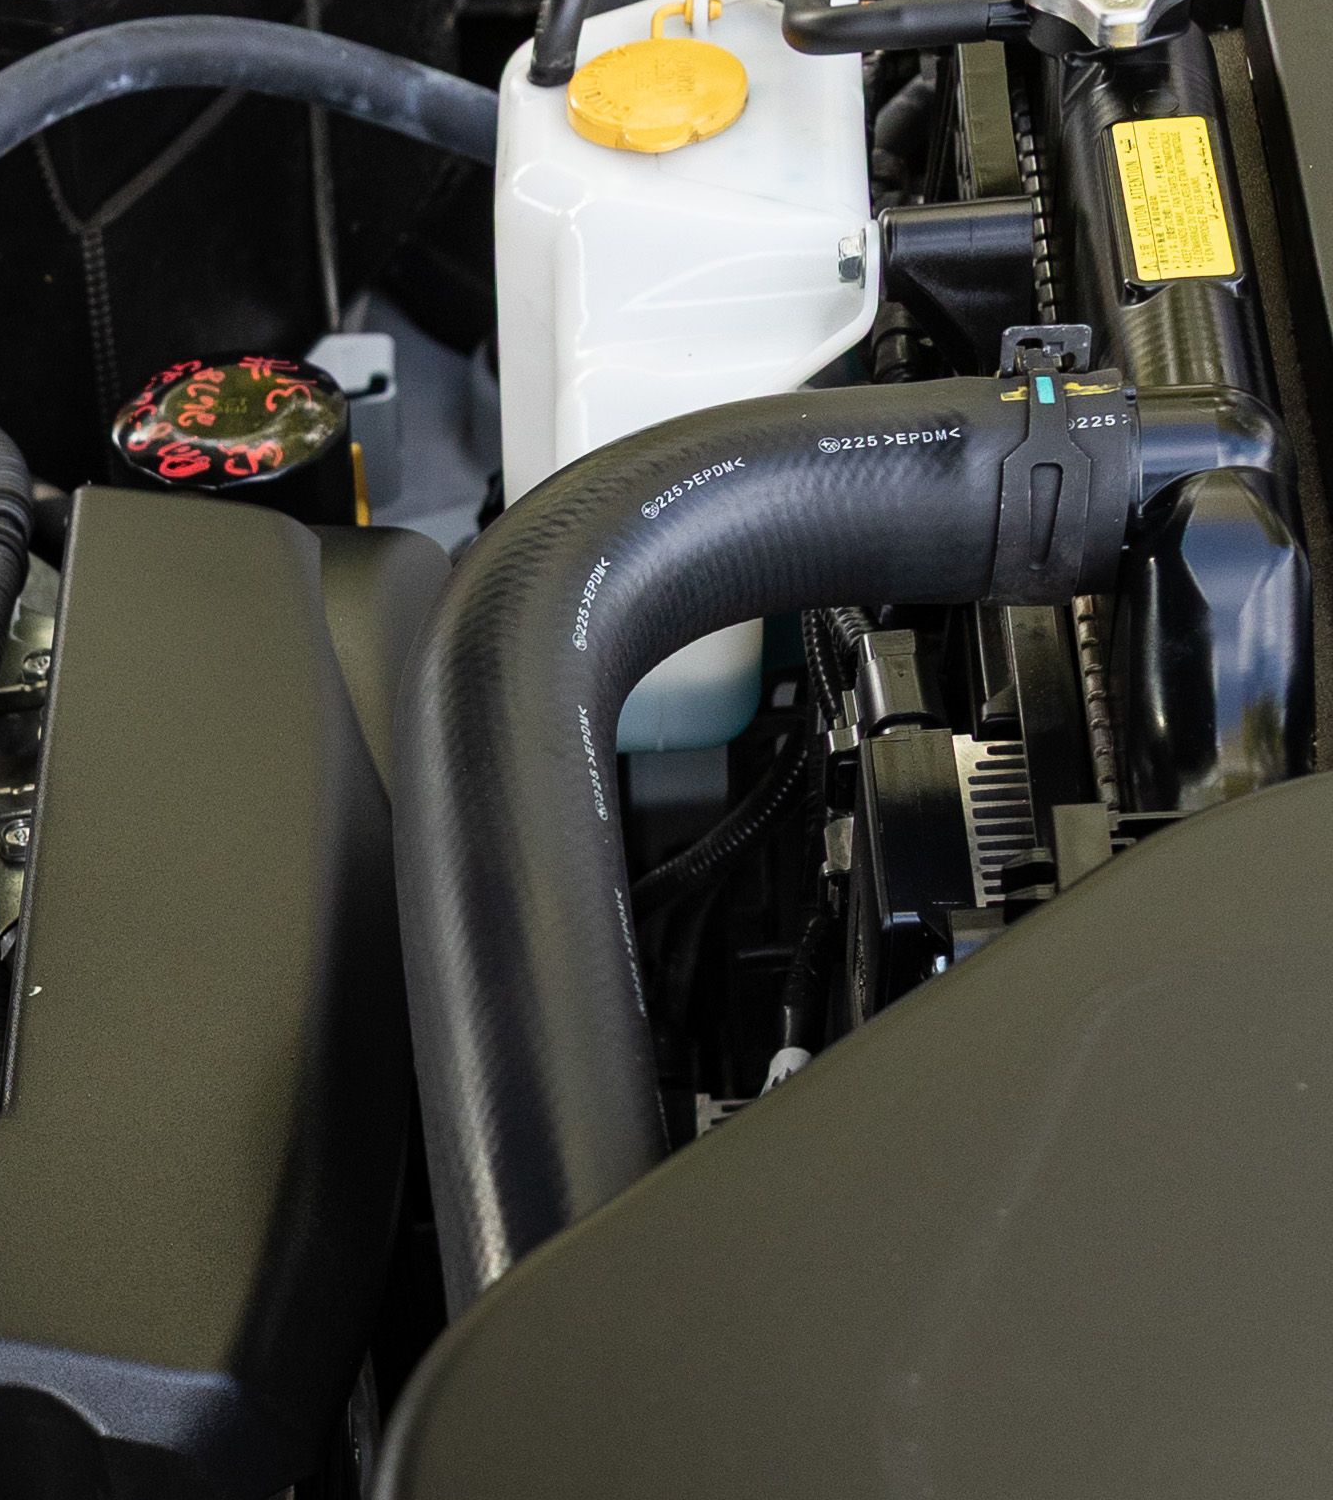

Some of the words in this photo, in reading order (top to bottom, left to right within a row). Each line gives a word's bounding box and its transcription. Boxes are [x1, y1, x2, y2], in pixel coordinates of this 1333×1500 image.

[1126, 160, 1142, 200] ATTENTION
[1133, 204, 1150, 238] CAUTION
[1076, 414, 1116, 429] 225
[840, 435, 878, 449] 225
[883, 427, 962, 446] >EPDM<
[655, 486, 681, 508] 225
[575, 608, 590, 635] 225
[589, 770, 603, 801] 225
